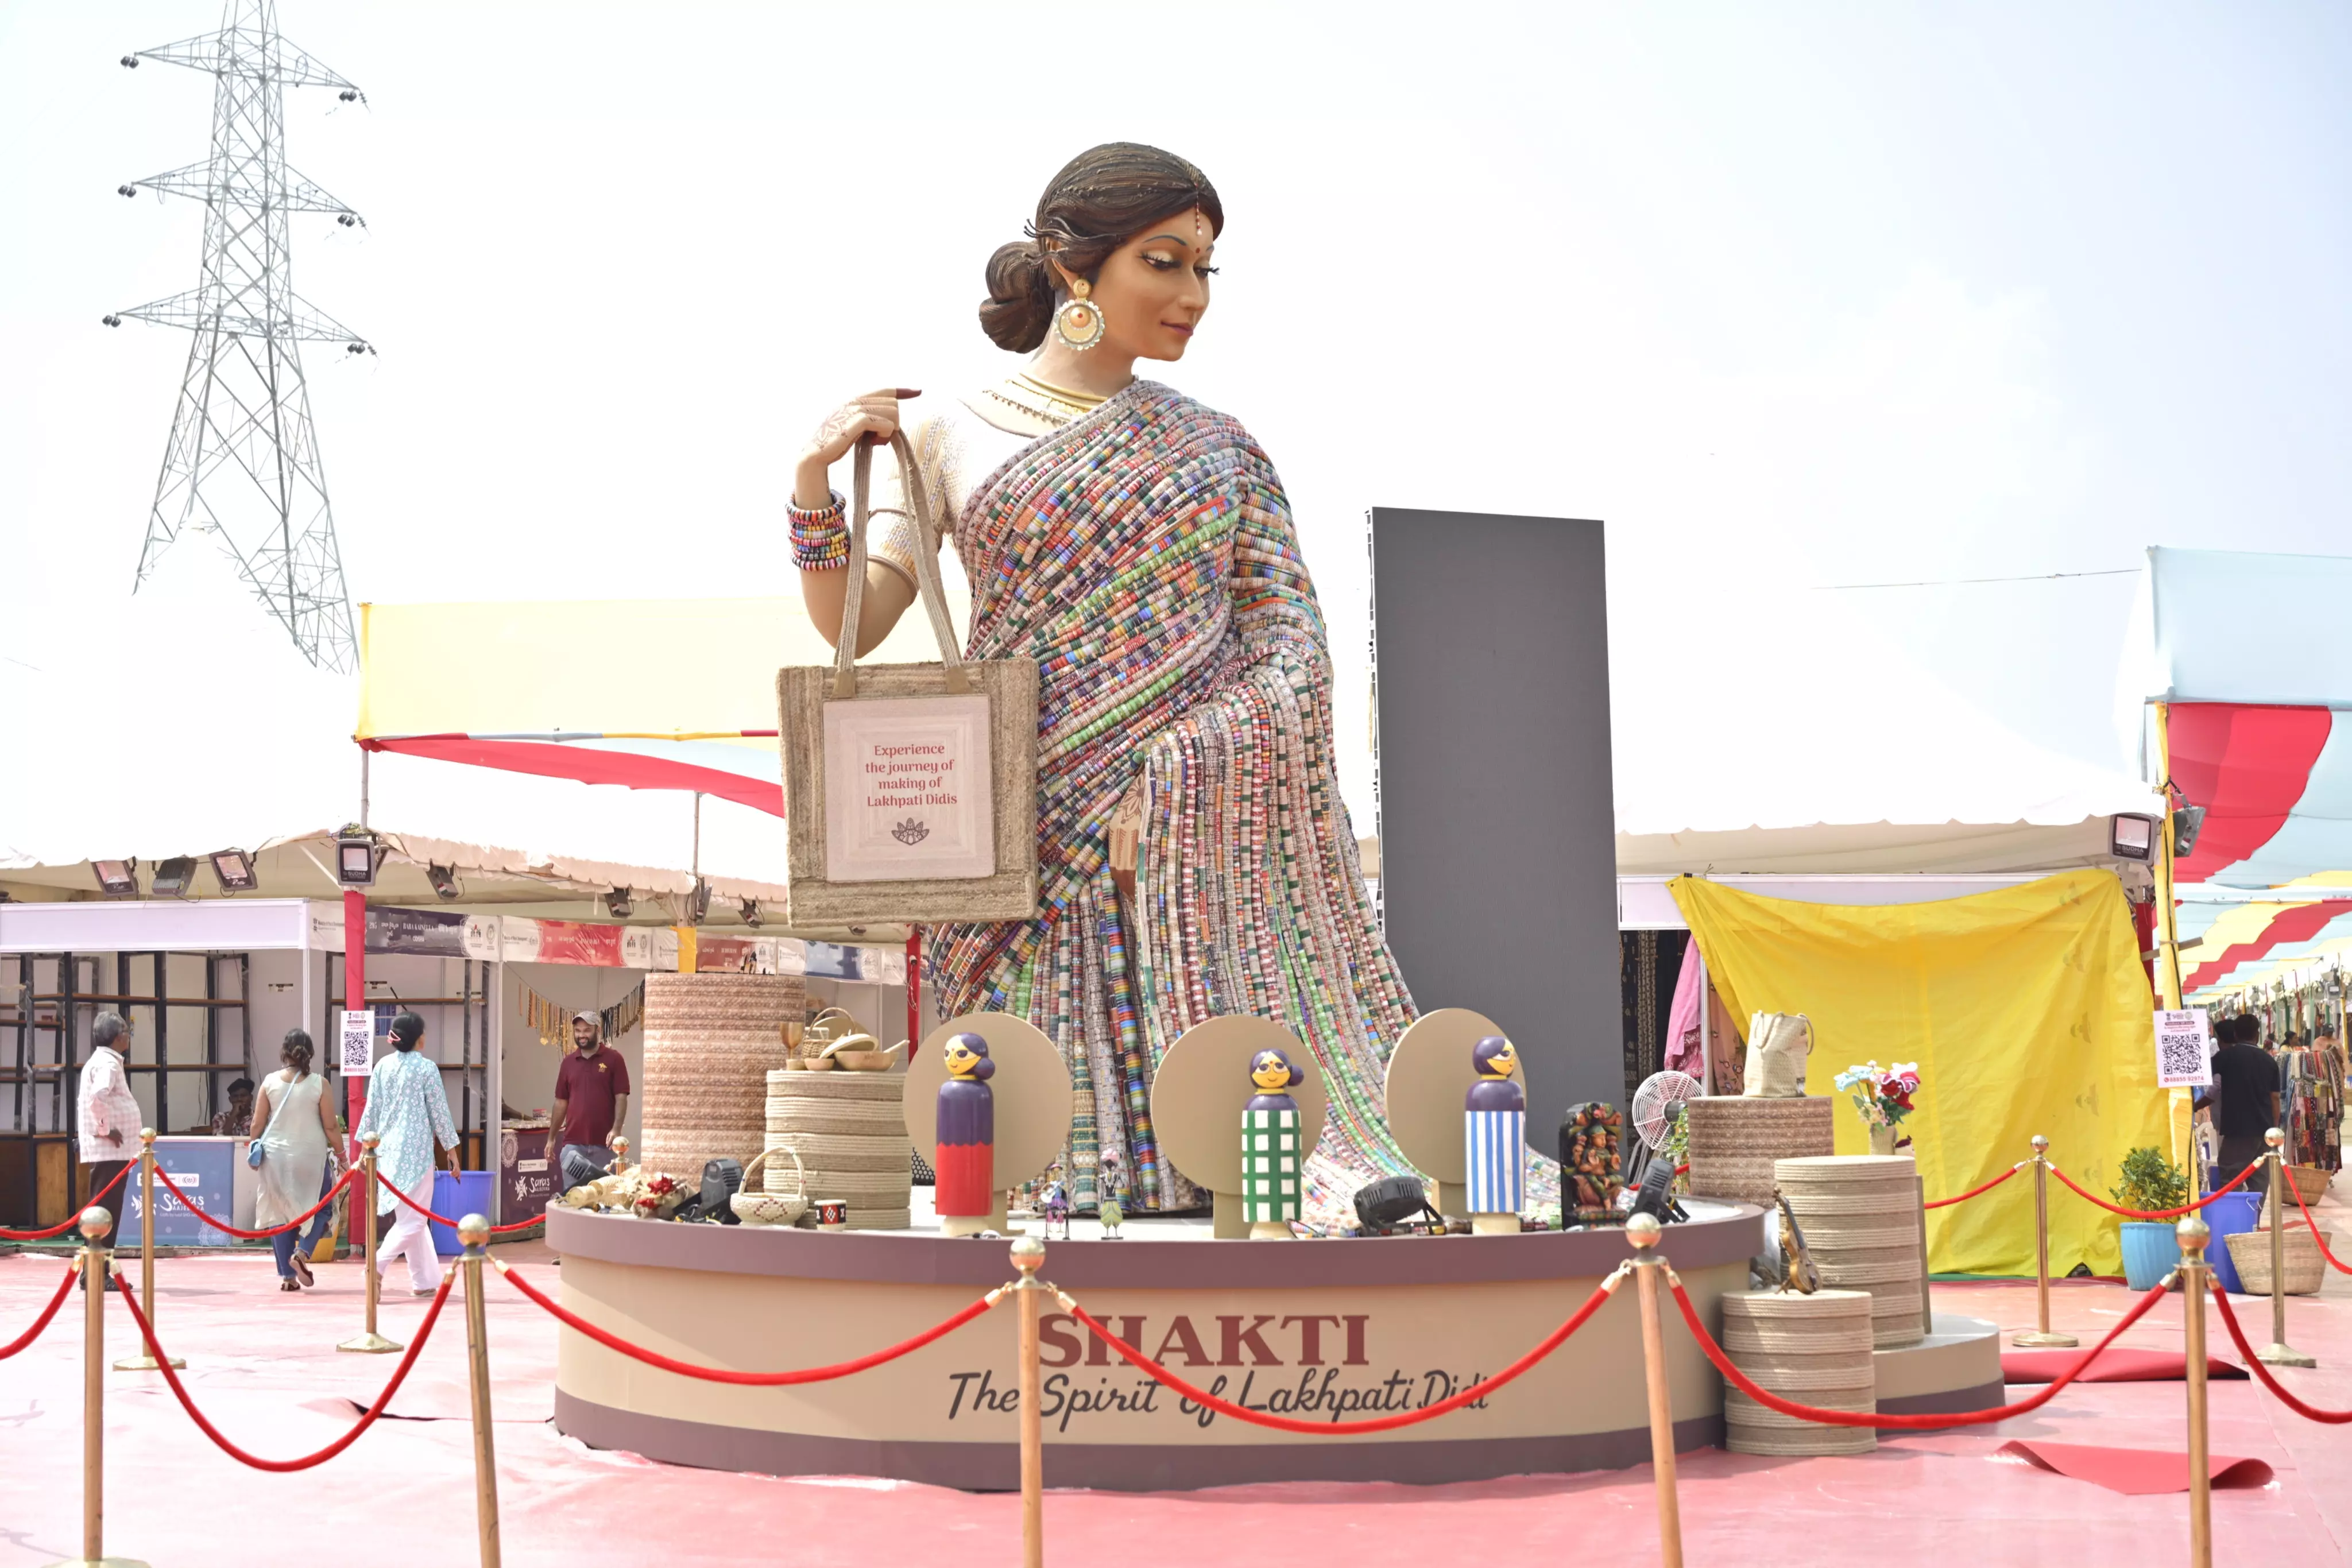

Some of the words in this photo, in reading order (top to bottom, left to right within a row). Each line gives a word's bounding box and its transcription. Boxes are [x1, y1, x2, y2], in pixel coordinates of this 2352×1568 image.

[874, 744, 945, 758] Experience
[865, 762, 885, 773] the
[887, 761, 938, 775] journey
[941, 759, 955, 771] of
[879, 777, 926, 791] making
[929, 776, 943, 788] of
[867, 794, 922, 808] Lakhpati
[926, 793, 958, 805] Didis
[529, 1177, 550, 1193] Saras
[160, 1193, 204, 1211] Saas
[1039, 1313, 1370, 1368] SHAKTI
[948, 1369, 1020, 1420] The
[1040, 1373, 1166, 1433] Spirit
[1179, 1375, 1228, 1428] of
[1238, 1367, 1414, 1424] Lakhpati
[1417, 1369, 1488, 1410] Didi
